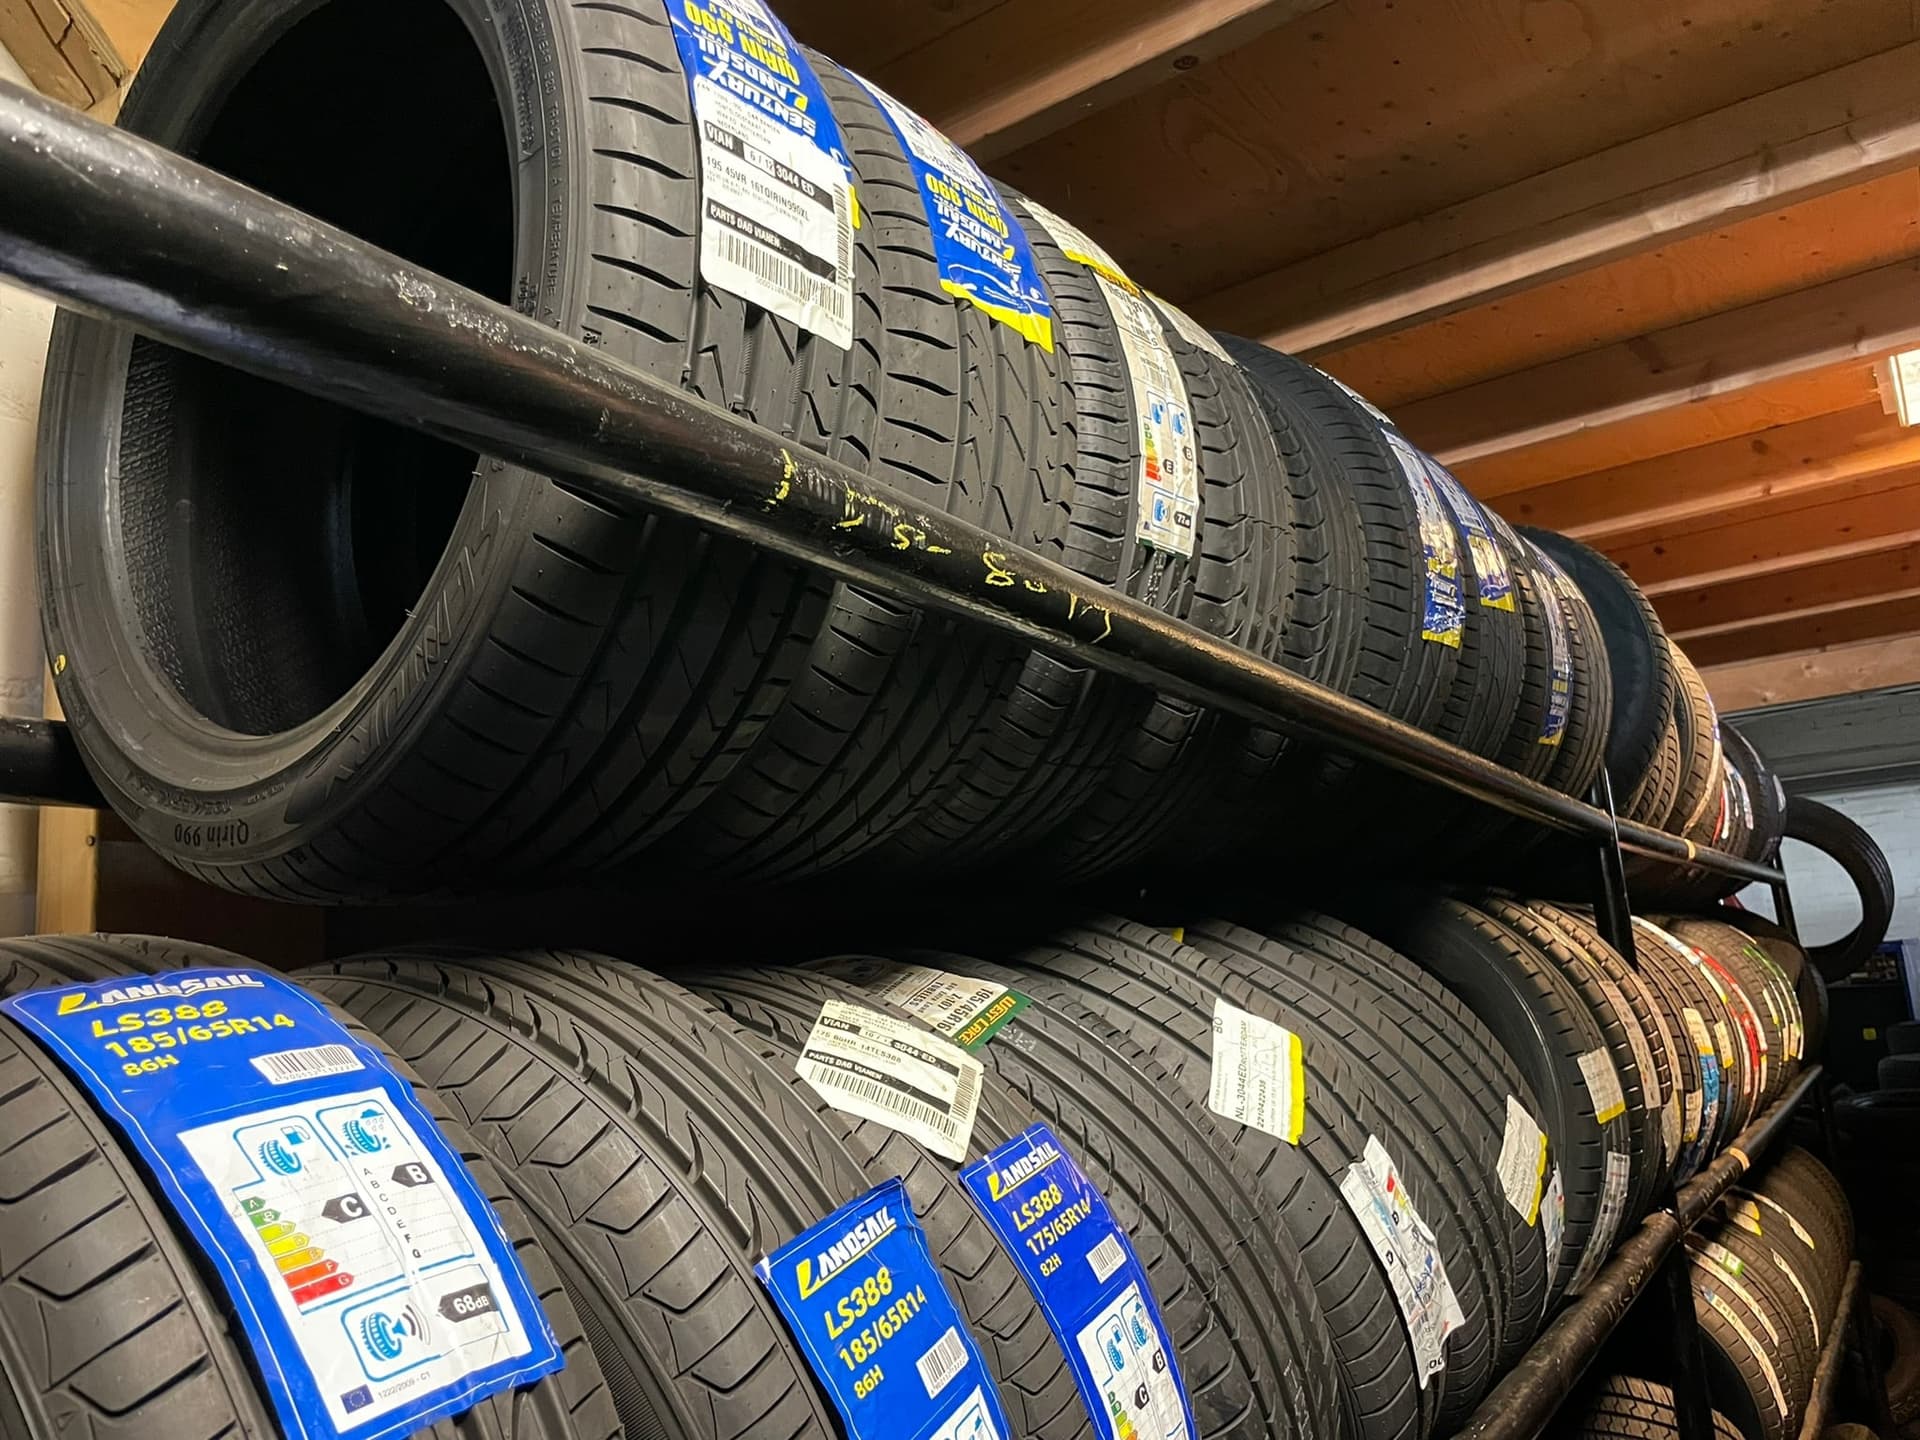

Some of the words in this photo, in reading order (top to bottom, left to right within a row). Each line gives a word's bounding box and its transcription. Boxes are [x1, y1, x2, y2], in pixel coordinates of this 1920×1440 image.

[684, 1, 734, 45] 990
[693, 32, 808, 112] LANDSAIL
[739, 32, 800, 86] QIRIN
[705, 57, 817, 137] SENTURY
[547, 100, 563, 168] TRACTION
[706, 156, 723, 172] 195
[775, 163, 800, 188] 3044
[710, 203, 736, 226] PARTS
[547, 195, 563, 297] TEMPERATURE
[174, 823, 201, 847] 990
[207, 818, 249, 848] Qirin
[91, 999, 229, 1037] LS388
[823, 1017, 850, 1030] VIAN
[936, 988, 995, 1032] 195/45R16
[105, 1013, 296, 1058] 185/65R14
[122, 1054, 180, 1076] 86H
[809, 1052, 834, 1065] PARTS
[405, 1164, 428, 1184] B
[987, 1141, 1061, 1202] LANDSAIL
[340, 1196, 362, 1217] C
[1012, 1183, 1064, 1233] LS388
[1026, 1196, 1091, 1257] 175/65R14
[796, 1205, 898, 1300] LANDSAIL
[1039, 1253, 1063, 1277] 82H
[453, 1294, 489, 1314] 68dB
[824, 1265, 893, 1341] LS388
[839, 1284, 928, 1372] 185/65R14
[854, 1363, 885, 1400] 86H
